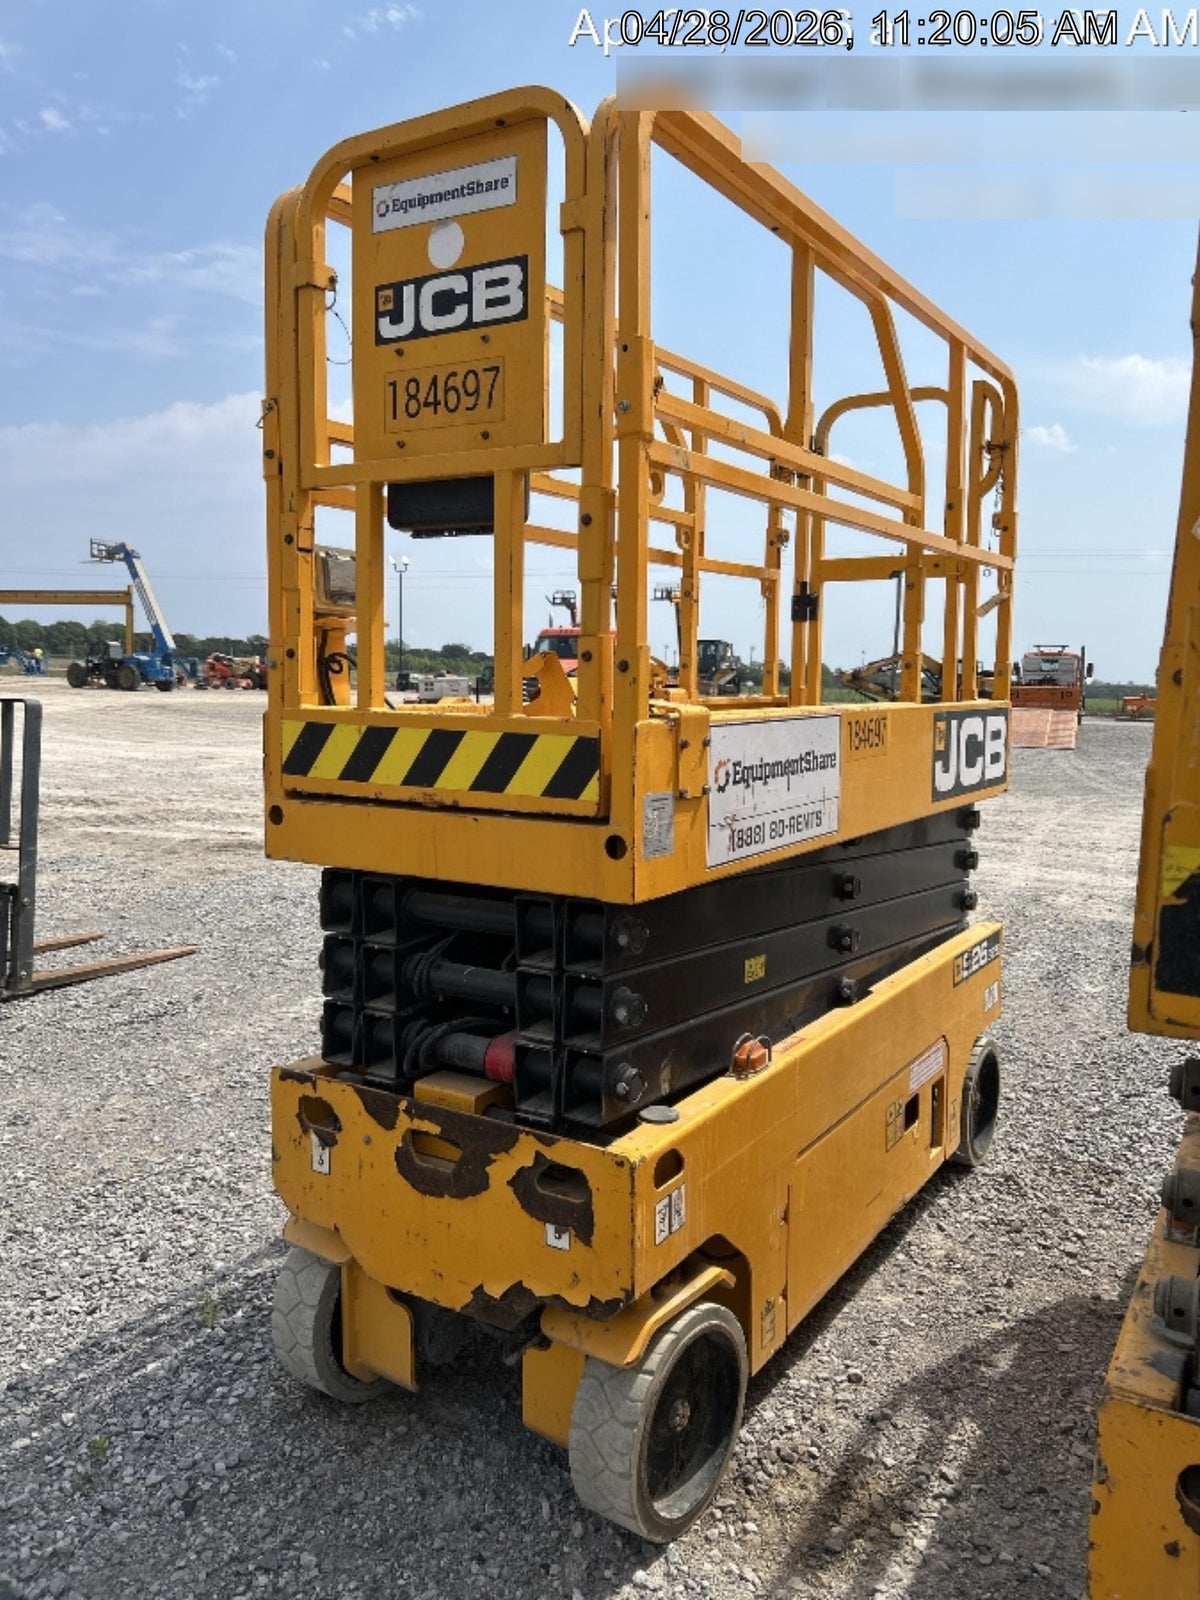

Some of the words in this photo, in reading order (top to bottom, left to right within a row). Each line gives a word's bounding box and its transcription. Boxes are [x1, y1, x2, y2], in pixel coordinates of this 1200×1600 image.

[392, 177, 509, 213] EquipmentShare
[378, 263, 524, 339] JCB
[388, 365, 500, 420] 184697
[847, 717, 886, 751] 184697
[934, 716, 1007, 792] JCB
[732, 751, 837, 789] EquipmentShare
